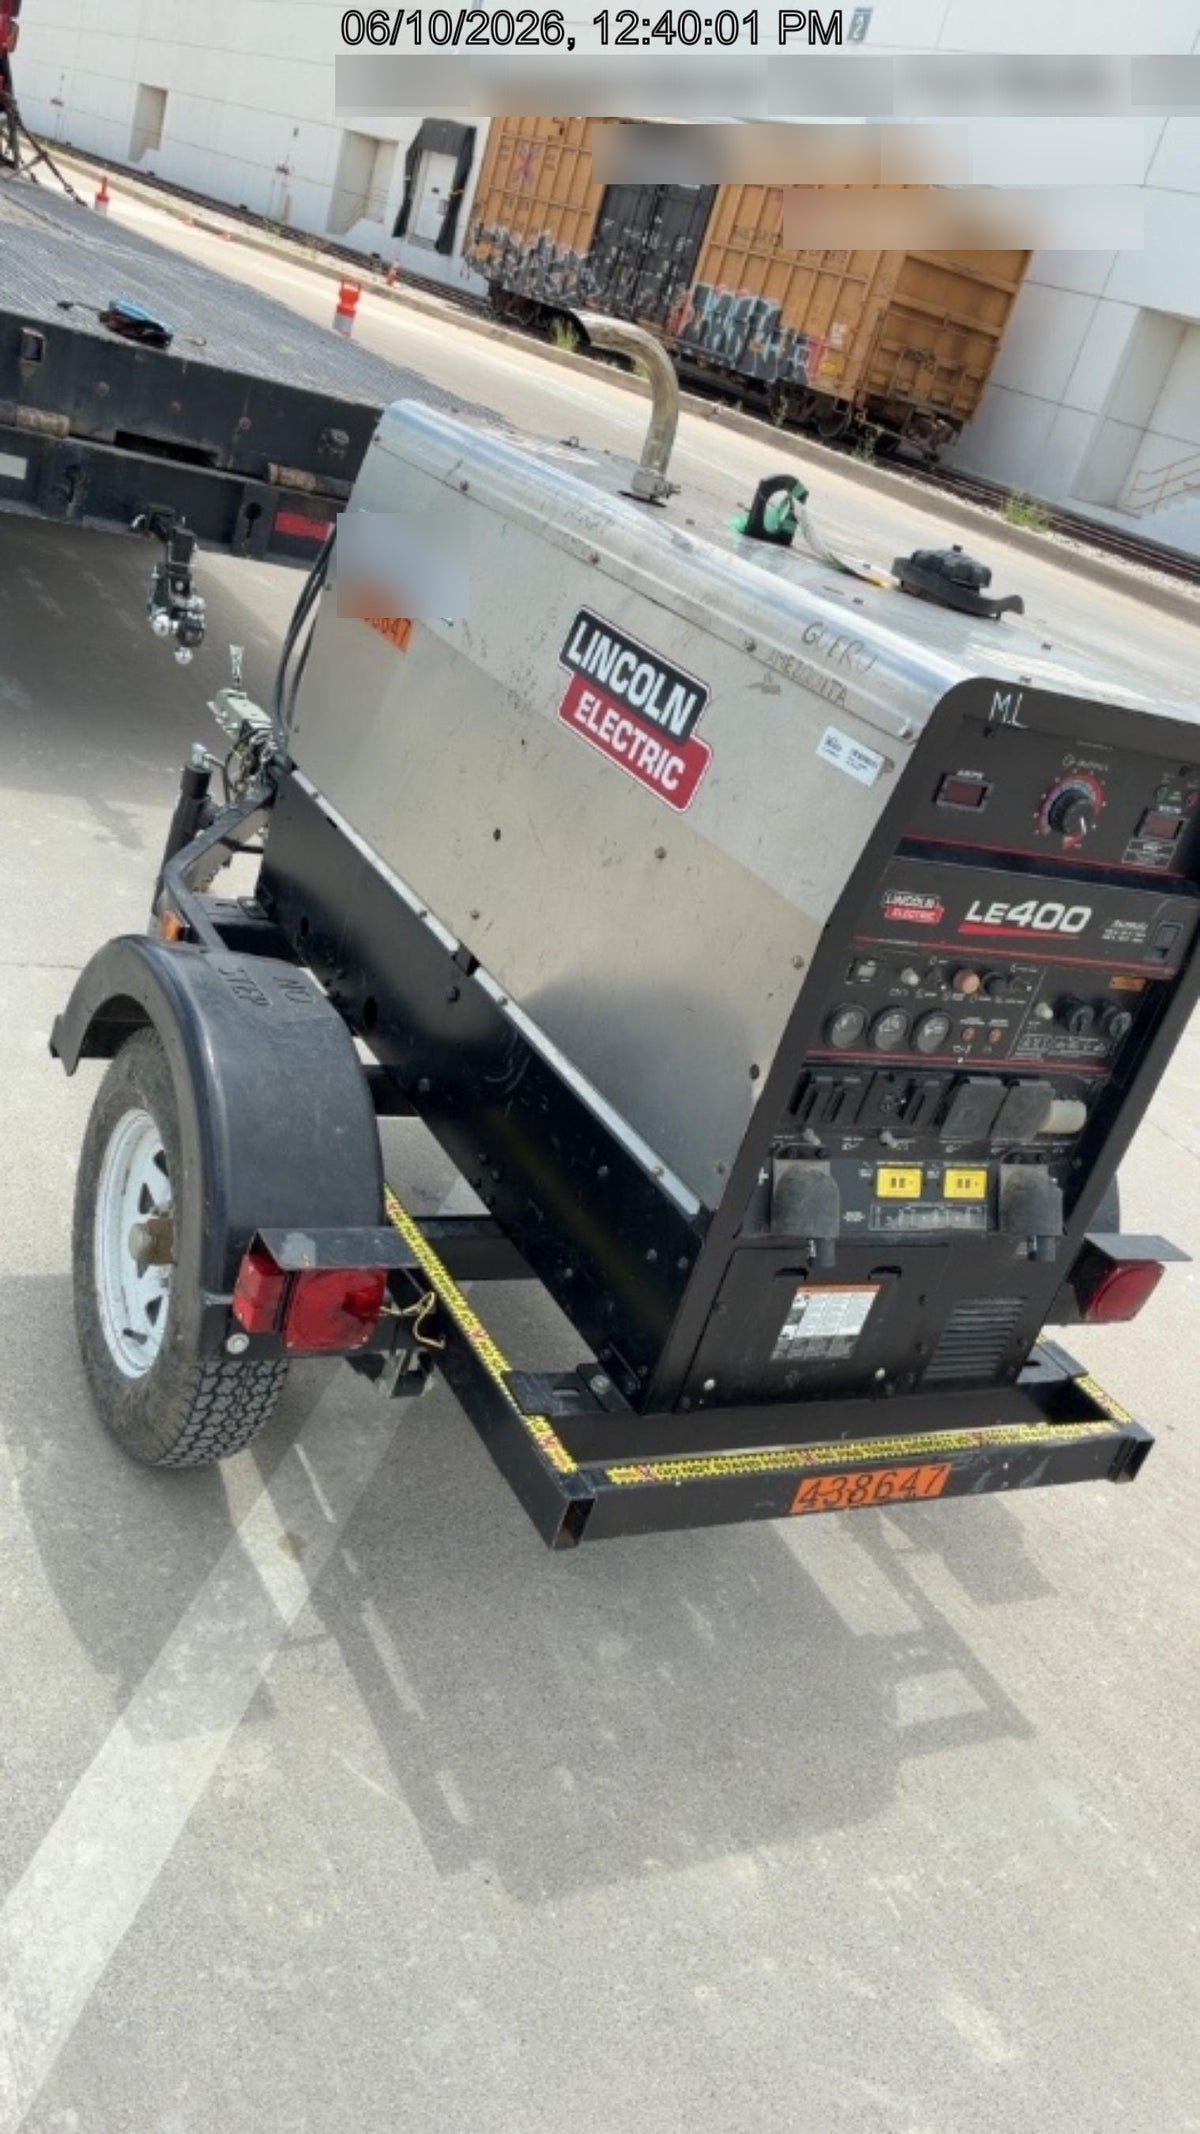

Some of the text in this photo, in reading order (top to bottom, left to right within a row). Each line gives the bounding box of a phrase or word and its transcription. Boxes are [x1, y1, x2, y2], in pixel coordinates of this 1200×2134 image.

[566, 620, 698, 737] LINCOLN
[573, 690, 686, 791] ELECTRIC
[965, 900, 1092, 933] LE400
[797, 1464, 947, 1507] 438647
